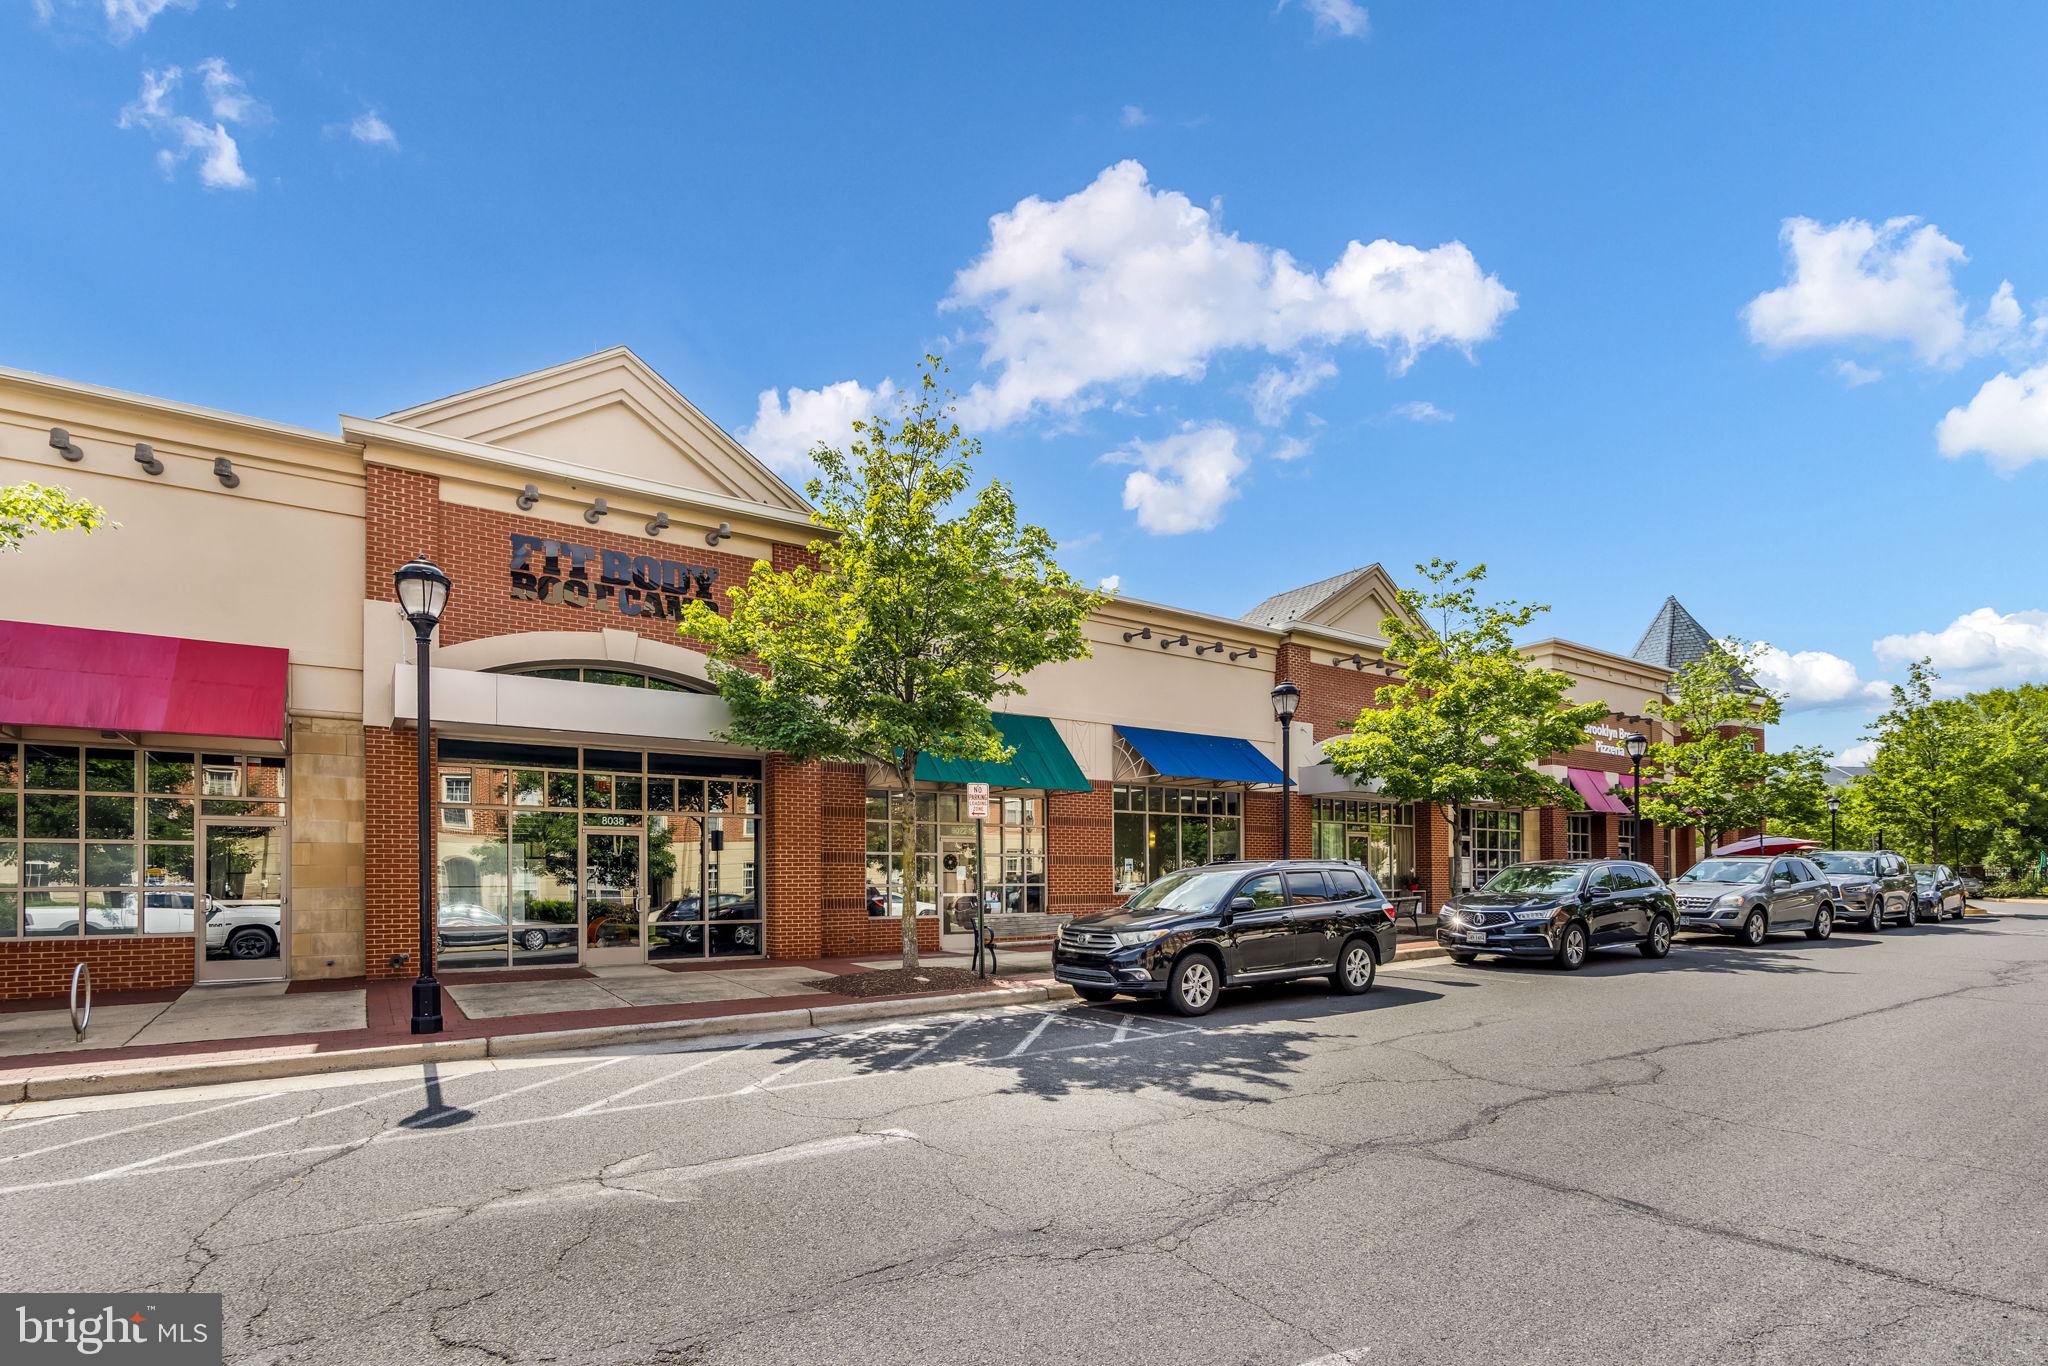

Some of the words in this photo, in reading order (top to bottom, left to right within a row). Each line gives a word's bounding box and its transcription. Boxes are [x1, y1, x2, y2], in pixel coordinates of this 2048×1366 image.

[510, 533, 596, 580] FIT
[600, 548, 719, 600] BODY
[510, 571, 615, 612] BOOT
[1583, 723, 1618, 741] Brooklyn
[1595, 740, 1625, 756] Pizzeria
[601, 816, 625, 826] 8038
